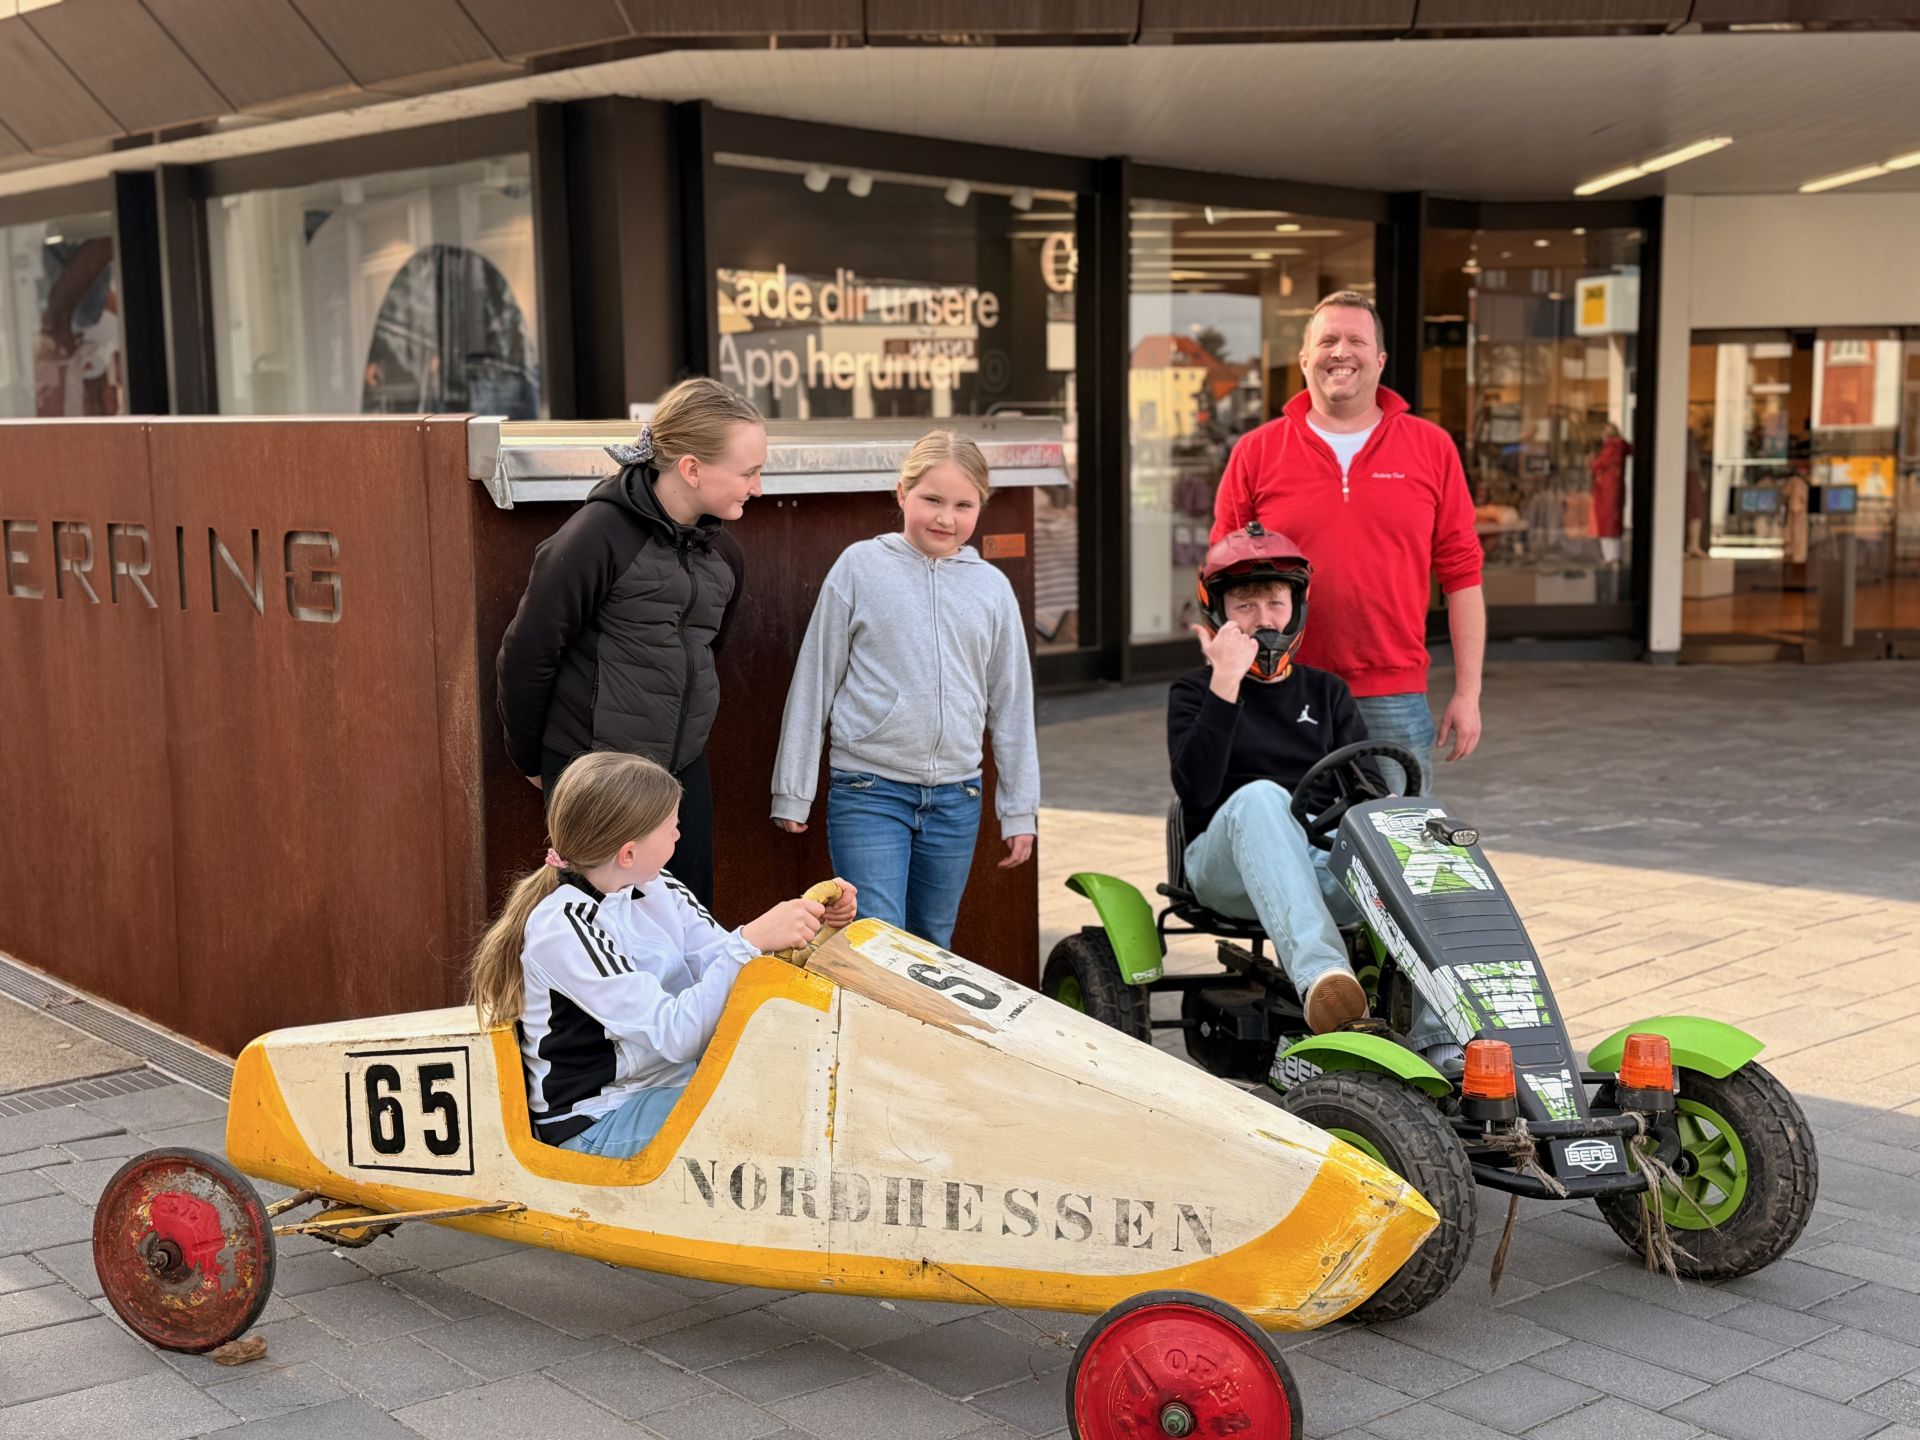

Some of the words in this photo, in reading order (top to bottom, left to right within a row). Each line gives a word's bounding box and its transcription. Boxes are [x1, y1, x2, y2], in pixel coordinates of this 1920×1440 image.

[718, 263, 812, 320] ade
[819, 267, 872, 321] dir
[879, 285, 1000, 328] unsere
[719, 333, 799, 399] App
[807, 334, 967, 390] herunter
[2, 519, 343, 624] ERRING
[365, 1061, 461, 1156] 65
[1568, 1148, 1614, 1162] BERG
[678, 1155, 1217, 1255] NORDHESSEN
